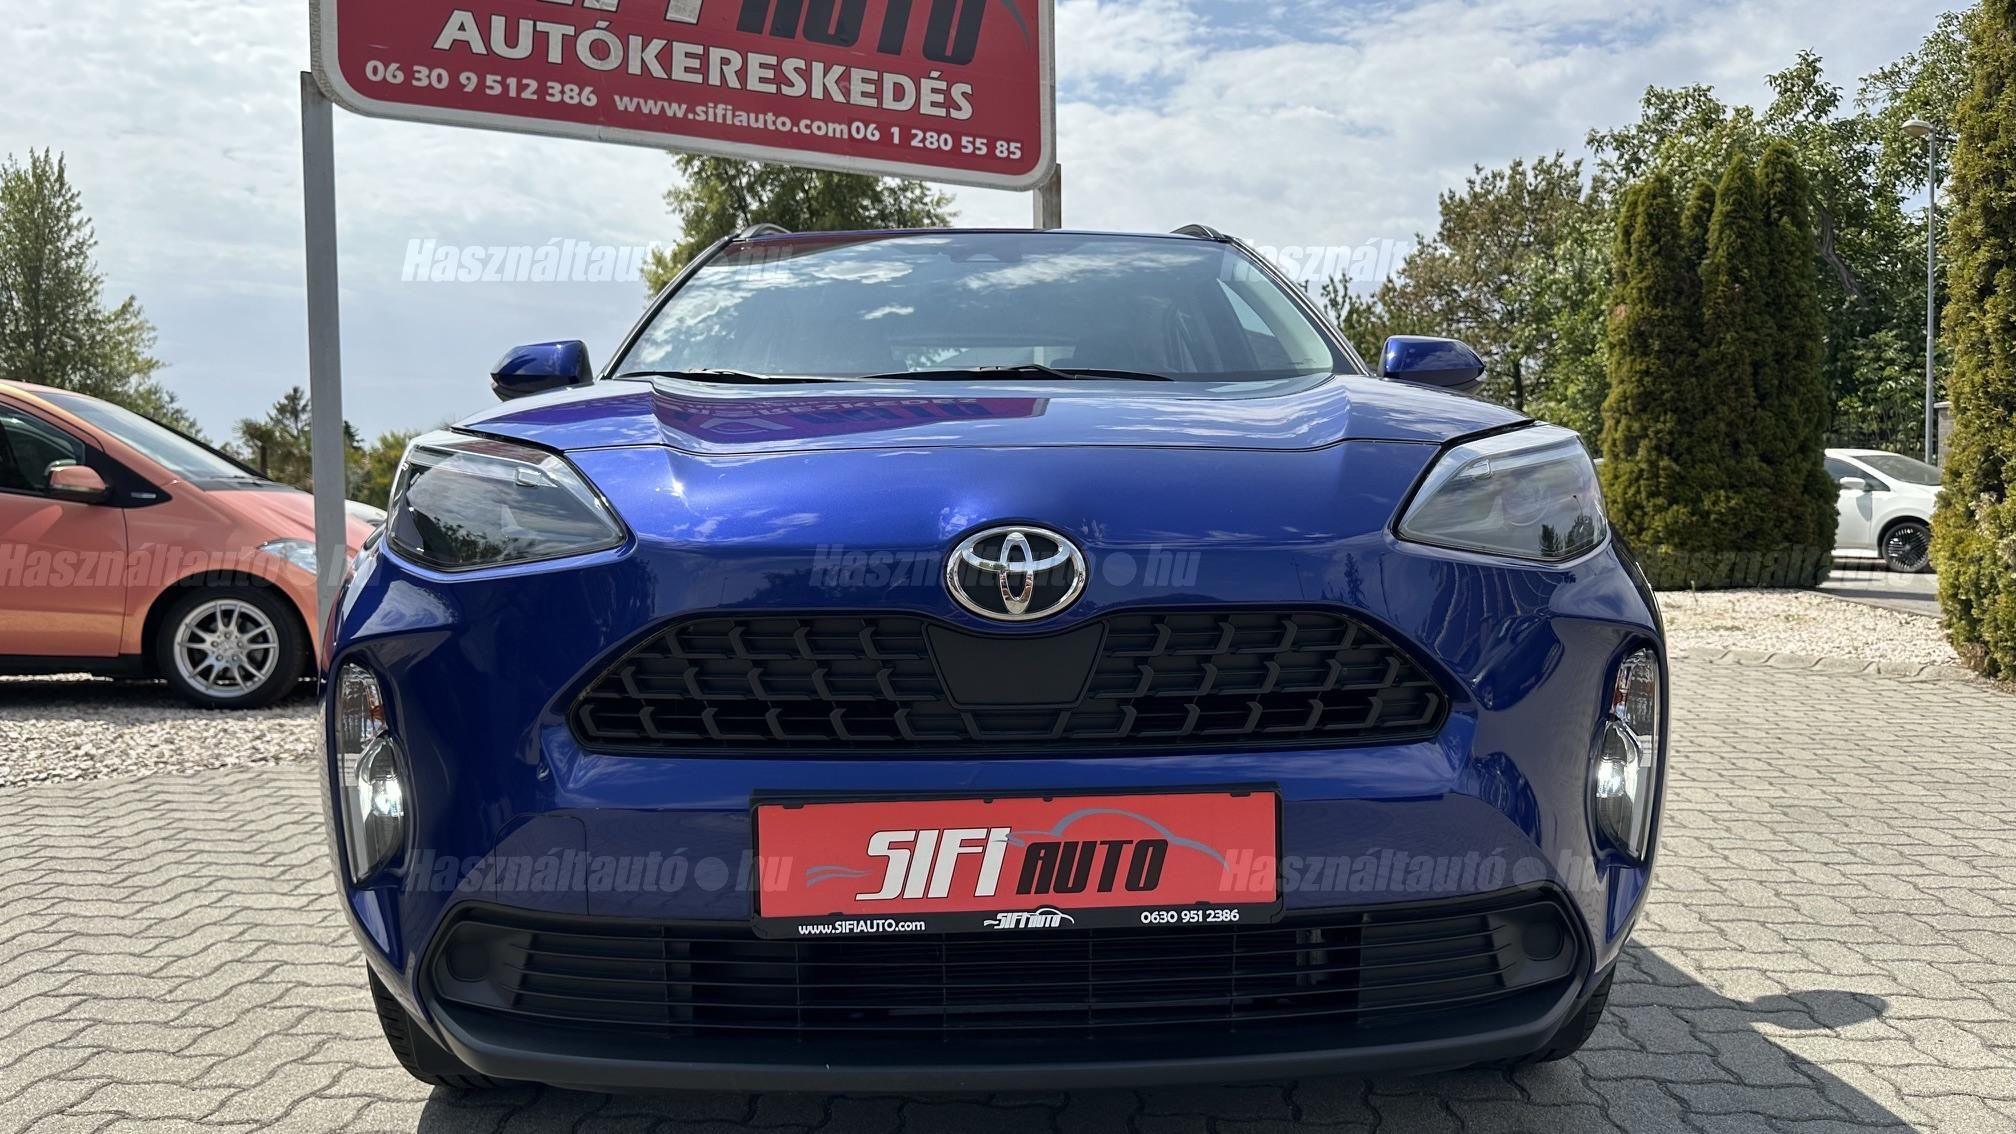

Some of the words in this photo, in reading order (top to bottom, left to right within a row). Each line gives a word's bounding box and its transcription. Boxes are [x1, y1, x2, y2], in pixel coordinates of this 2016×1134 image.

[364, 60, 404, 85] 06
[411, 65, 449, 90] 30
[458, 71, 478, 93] 9
[485, 75, 538, 100] 512
[545, 81, 598, 107] 386
[432, 9, 974, 121] AUTÓKERESKEDÉS
[613, 93, 848, 139] www.sifiauto.com
[850, 121, 881, 142] 06
[890, 126, 900, 145] 1
[911, 129, 953, 152] 280
[960, 136, 988, 156] 55
[994, 140, 1022, 160] 85
[855, 826, 1012, 901] SIFI
[1016, 839, 1168, 895] AUTO
[798, 919, 925, 935] www.SIFIAUTO.com
[1140, 911, 1177, 924] 0630
[1181, 910, 1203, 923] 951
[1206, 909, 1239, 922] 2386
